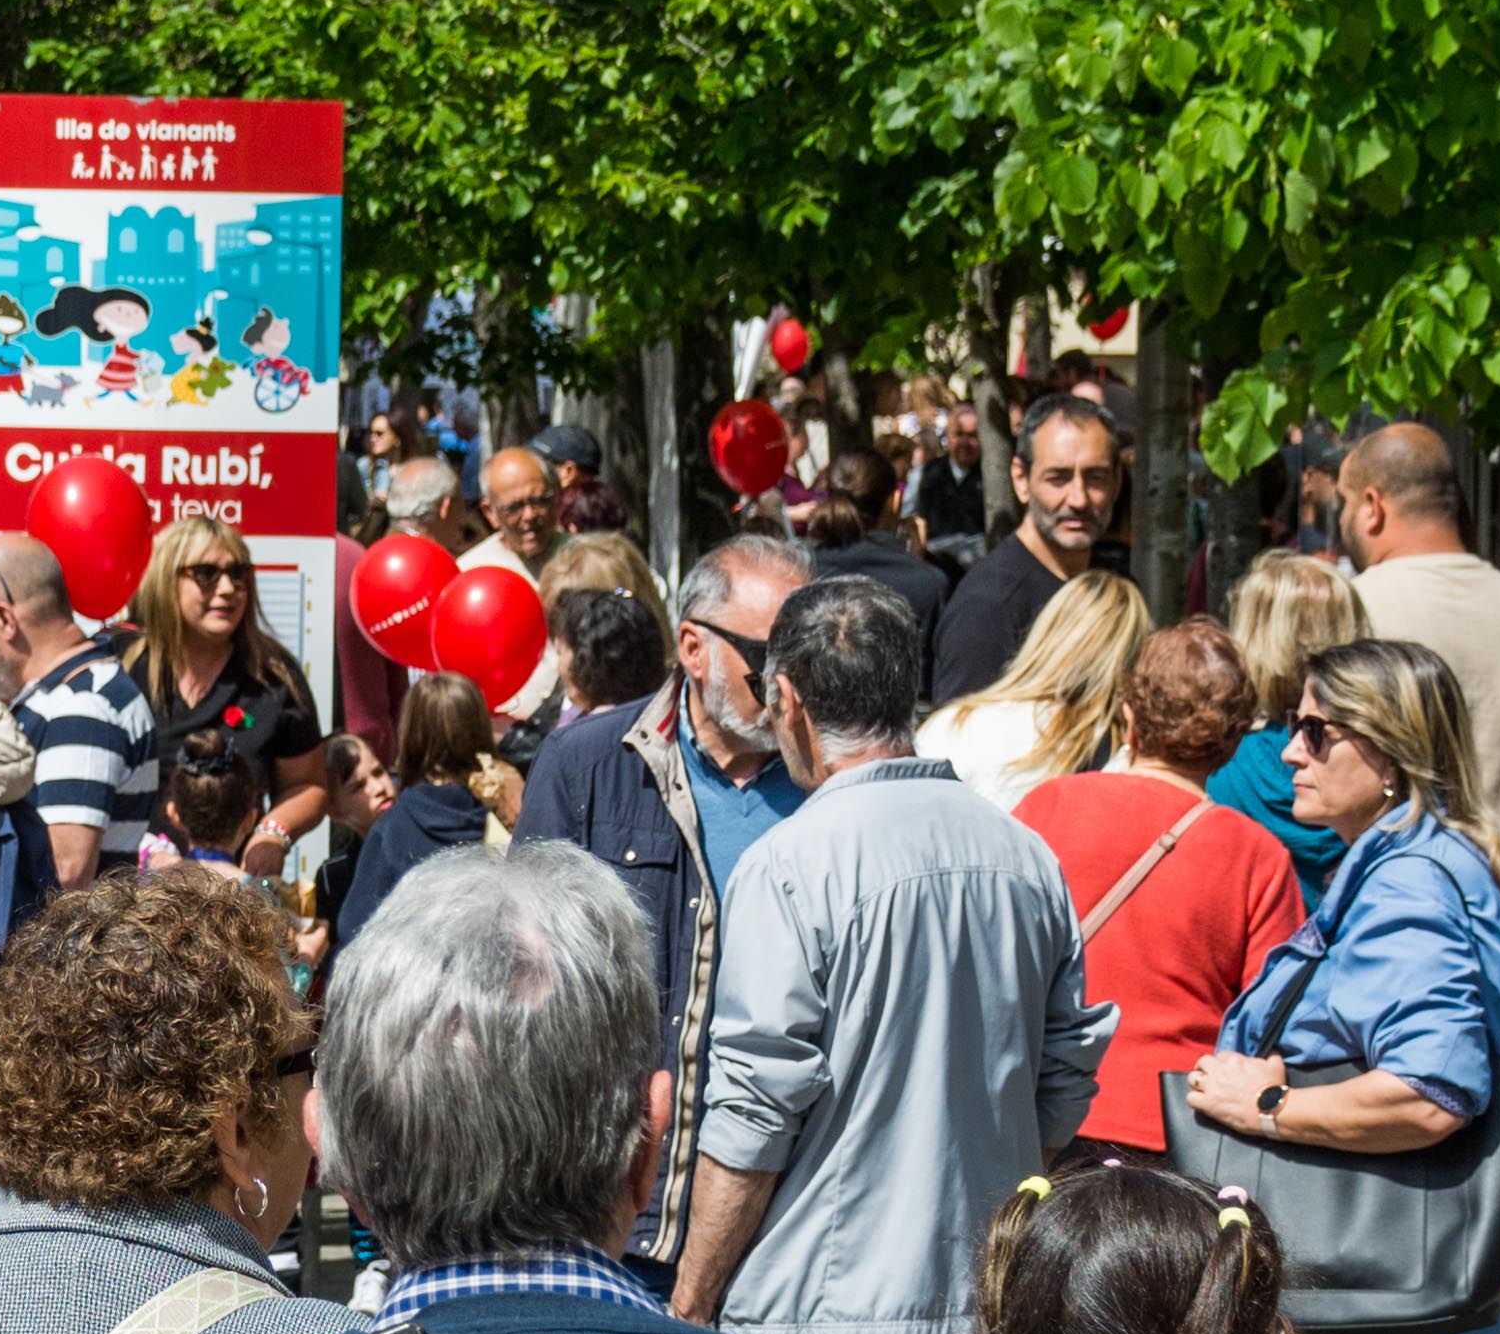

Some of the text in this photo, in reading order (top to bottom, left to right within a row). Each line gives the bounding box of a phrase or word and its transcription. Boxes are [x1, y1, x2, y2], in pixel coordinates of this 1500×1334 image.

[55, 117, 236, 143] Illa de vianants
[161, 443, 273, 490] Rubí,
[171, 493, 242, 524] teva
